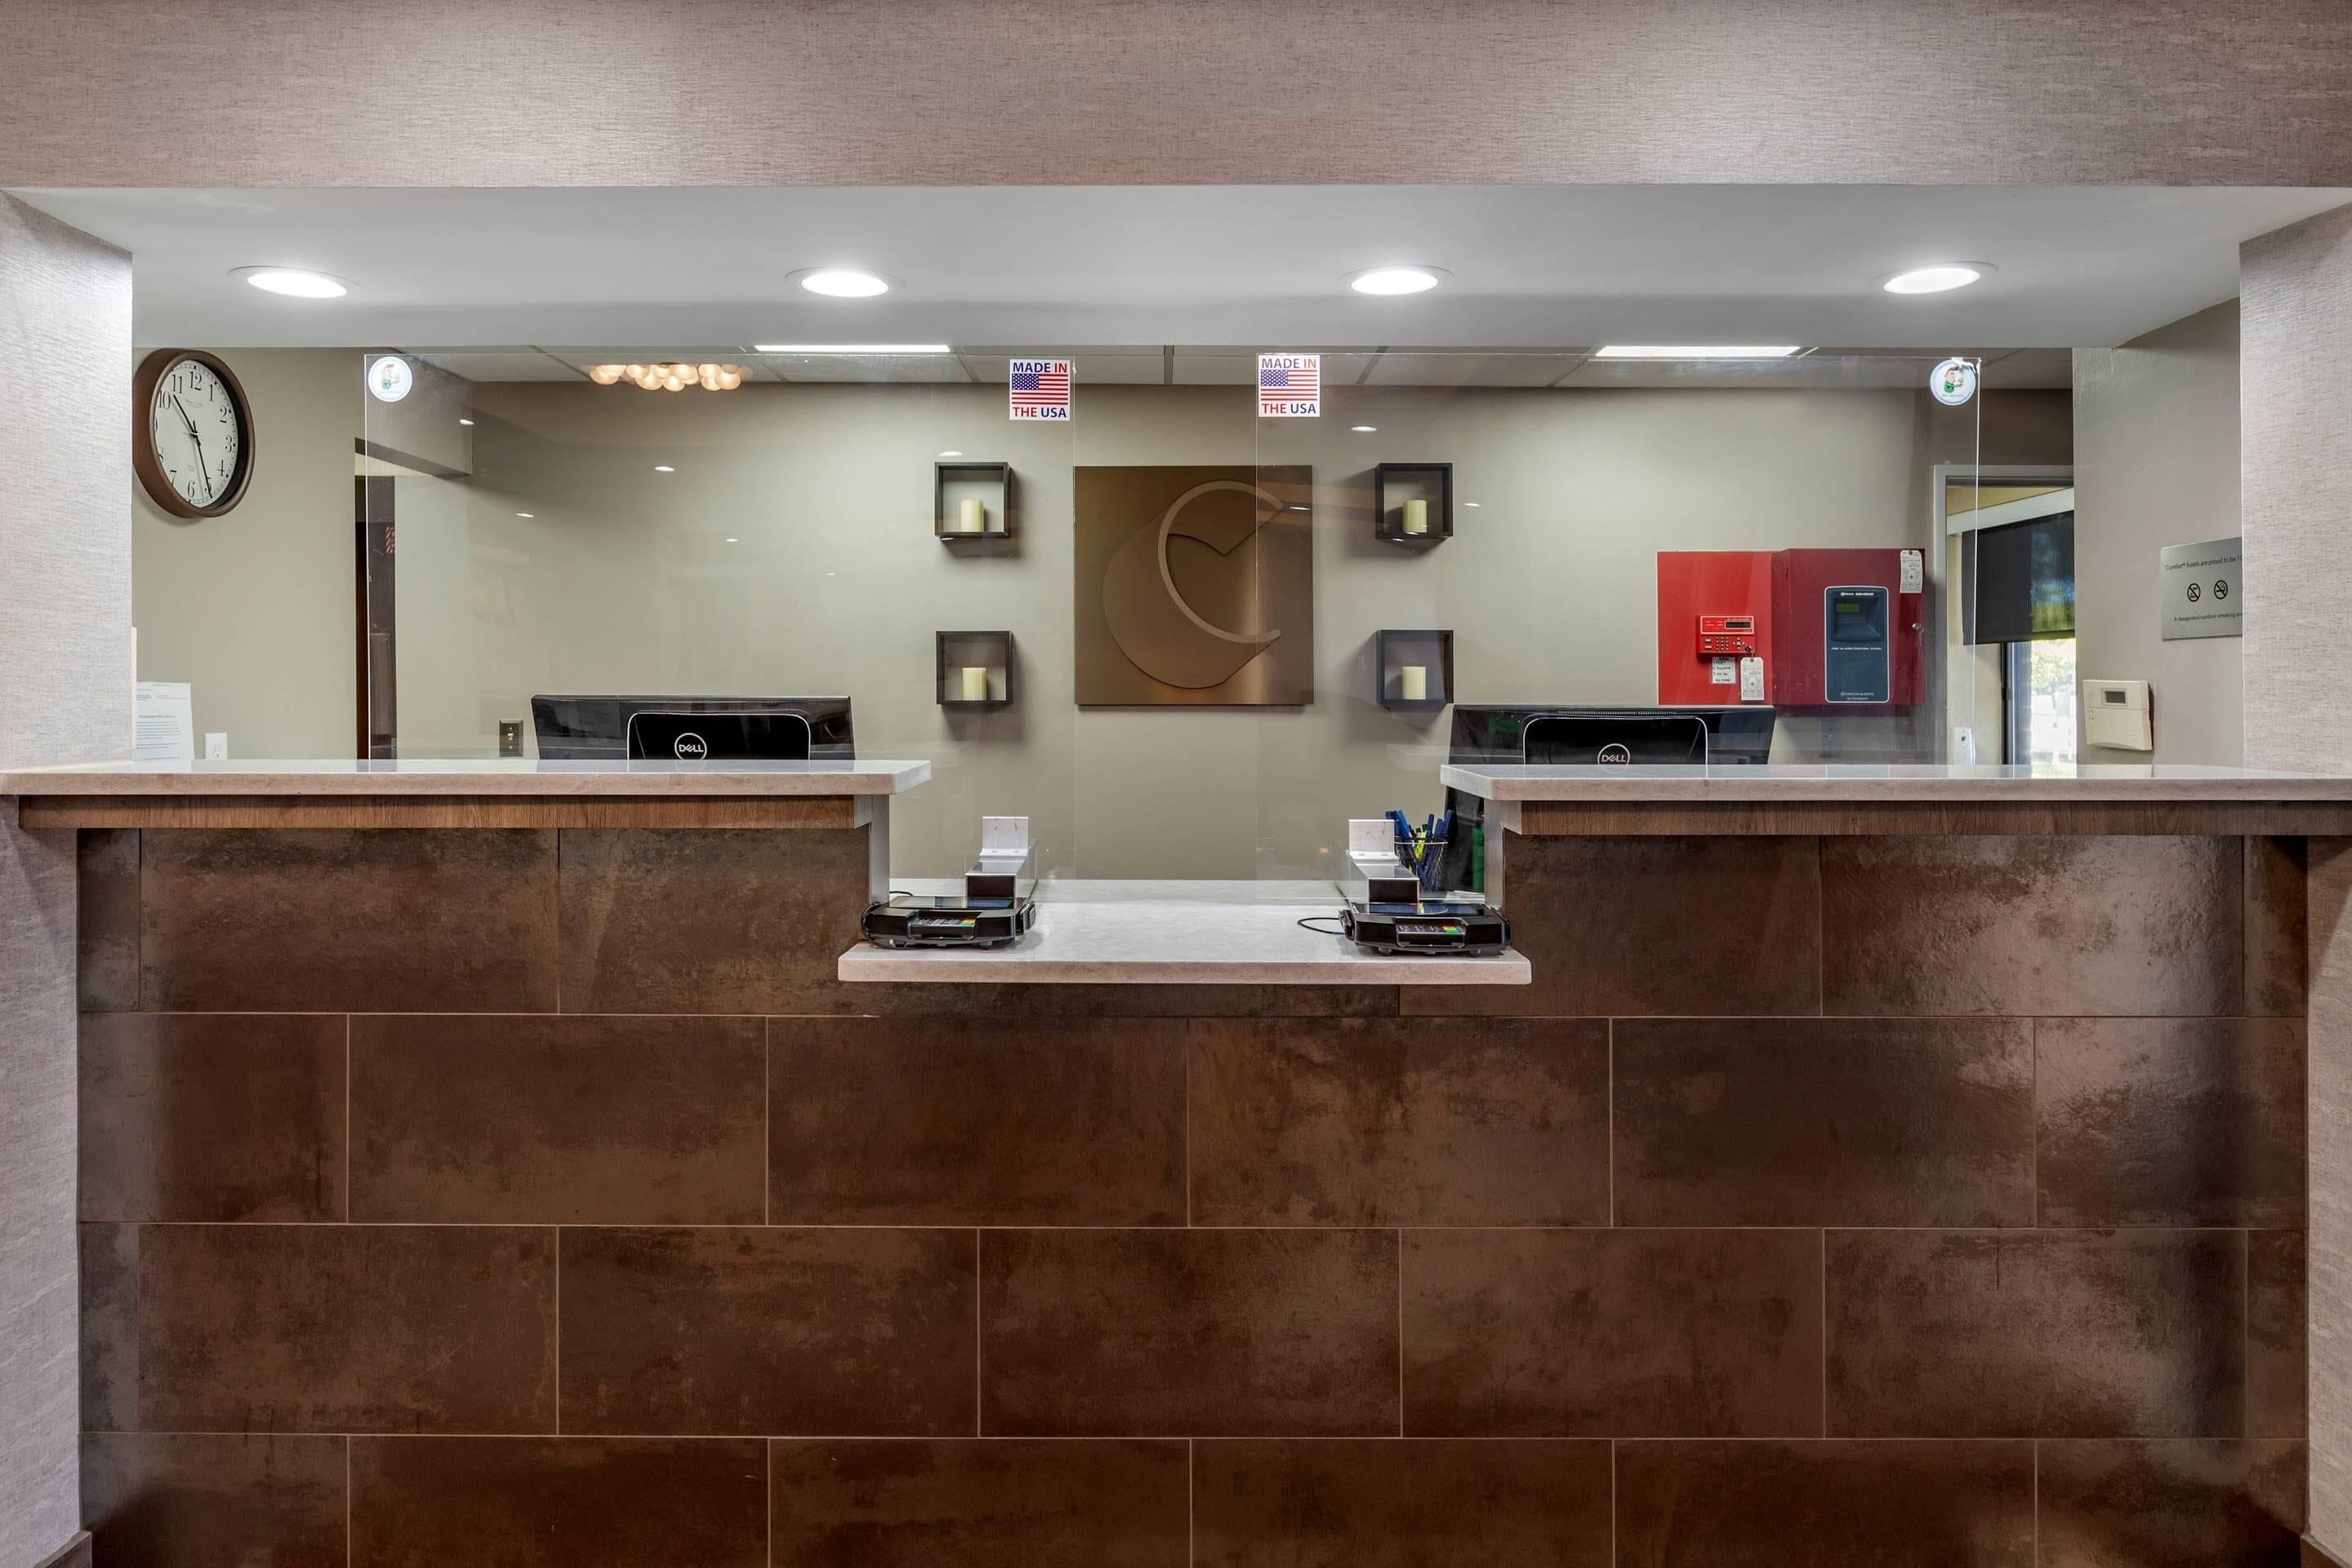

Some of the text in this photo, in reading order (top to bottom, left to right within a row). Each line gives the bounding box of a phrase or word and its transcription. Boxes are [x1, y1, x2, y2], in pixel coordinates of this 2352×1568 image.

[1013, 363, 1067, 373] MADE IN
[1262, 359, 1316, 368] MADE IN
[172, 374, 183, 394] 11
[189, 371, 203, 390] 12
[158, 391, 171, 409] 10
[208, 384, 214, 402] 1
[220, 405, 227, 424] 2
[1013, 407, 1067, 417] THE USA
[1262, 403, 1316, 414] THE USA
[225, 434, 233, 452] 3
[217, 459, 225, 477] 4
[170, 470, 177, 485] 7
[187, 479, 195, 498] 6
[2208, 558, 2222, 566] proud
[679, 744, 704, 752] DELL
[1601, 754, 1626, 762] DELL
